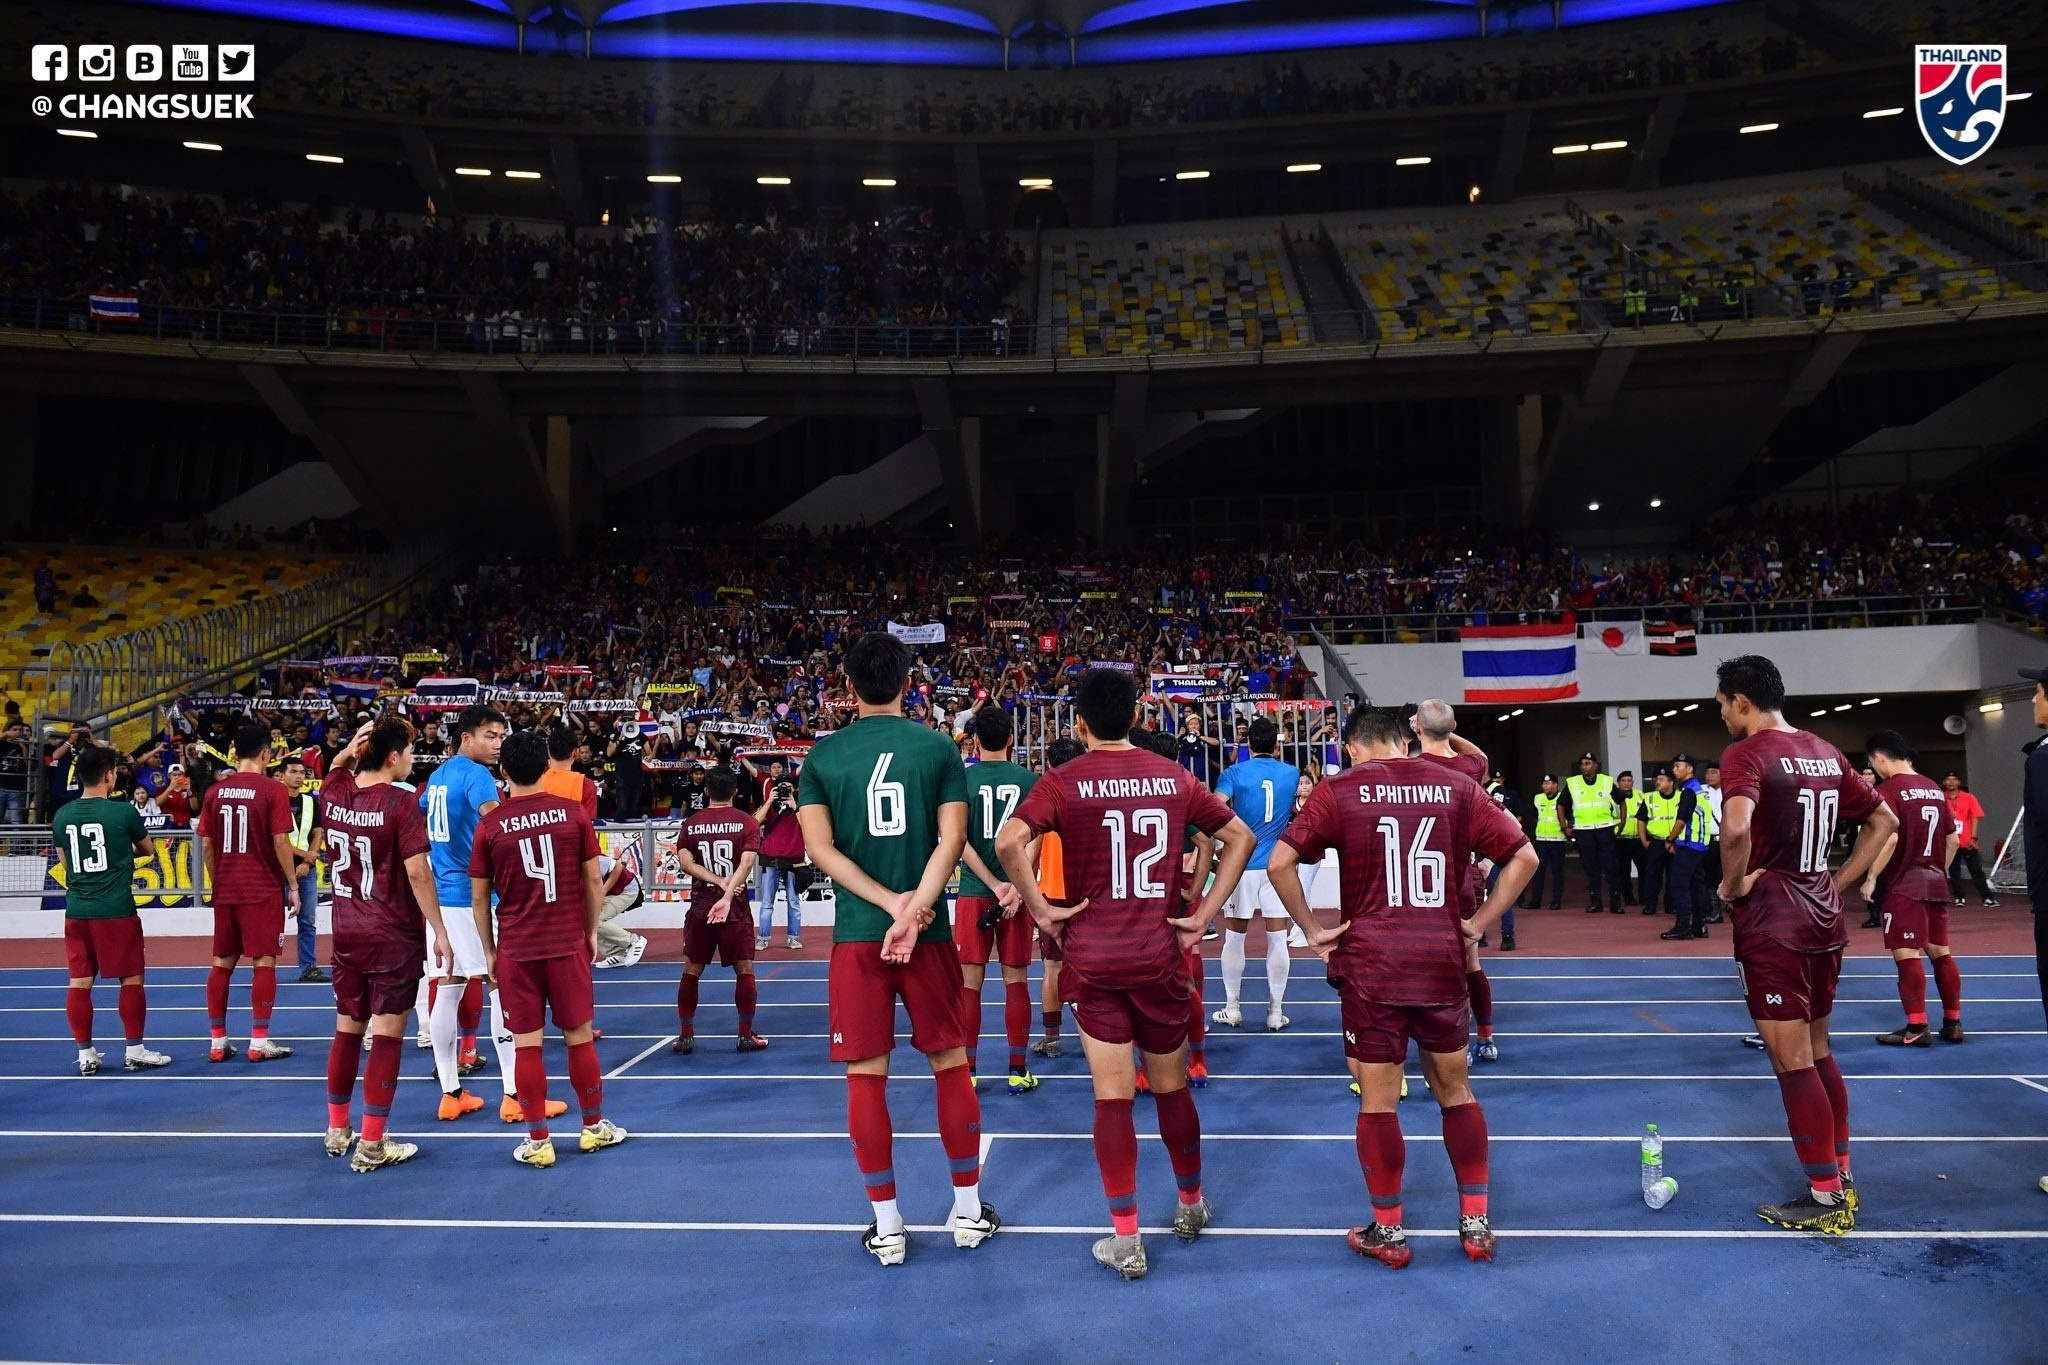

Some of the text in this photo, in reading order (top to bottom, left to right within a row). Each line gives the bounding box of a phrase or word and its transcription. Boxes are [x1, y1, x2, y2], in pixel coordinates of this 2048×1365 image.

[1172, 679, 1217, 687] THAILAND
[1195, 694, 1230, 703] THAILAND
[218, 787, 257, 800] P.BORDIN
[866, 752, 907, 837] 6
[1077, 777, 1178, 799] W.KORRAKOT
[1261, 779, 1275, 824] 1
[1359, 784, 1453, 805] S.PHITIWAT
[143, 815, 166, 827] AND
[219, 804, 248, 854] 11
[325, 801, 385, 827] T.SIVAKORN
[427, 784, 450, 843] 20
[499, 808, 568, 834] Y.SARACH
[687, 822, 744, 836] S.CHANATHIP
[978, 784, 1021, 840] 17
[1797, 788, 1839, 873] 10
[1921, 805, 1939, 857] 7
[65, 822, 108, 875] 13
[326, 828, 375, 901] 21
[518, 833, 557, 904] 4
[1102, 808, 1168, 900] 12
[1376, 816, 1446, 908] 16
[1884, 912, 1892, 934] 7
